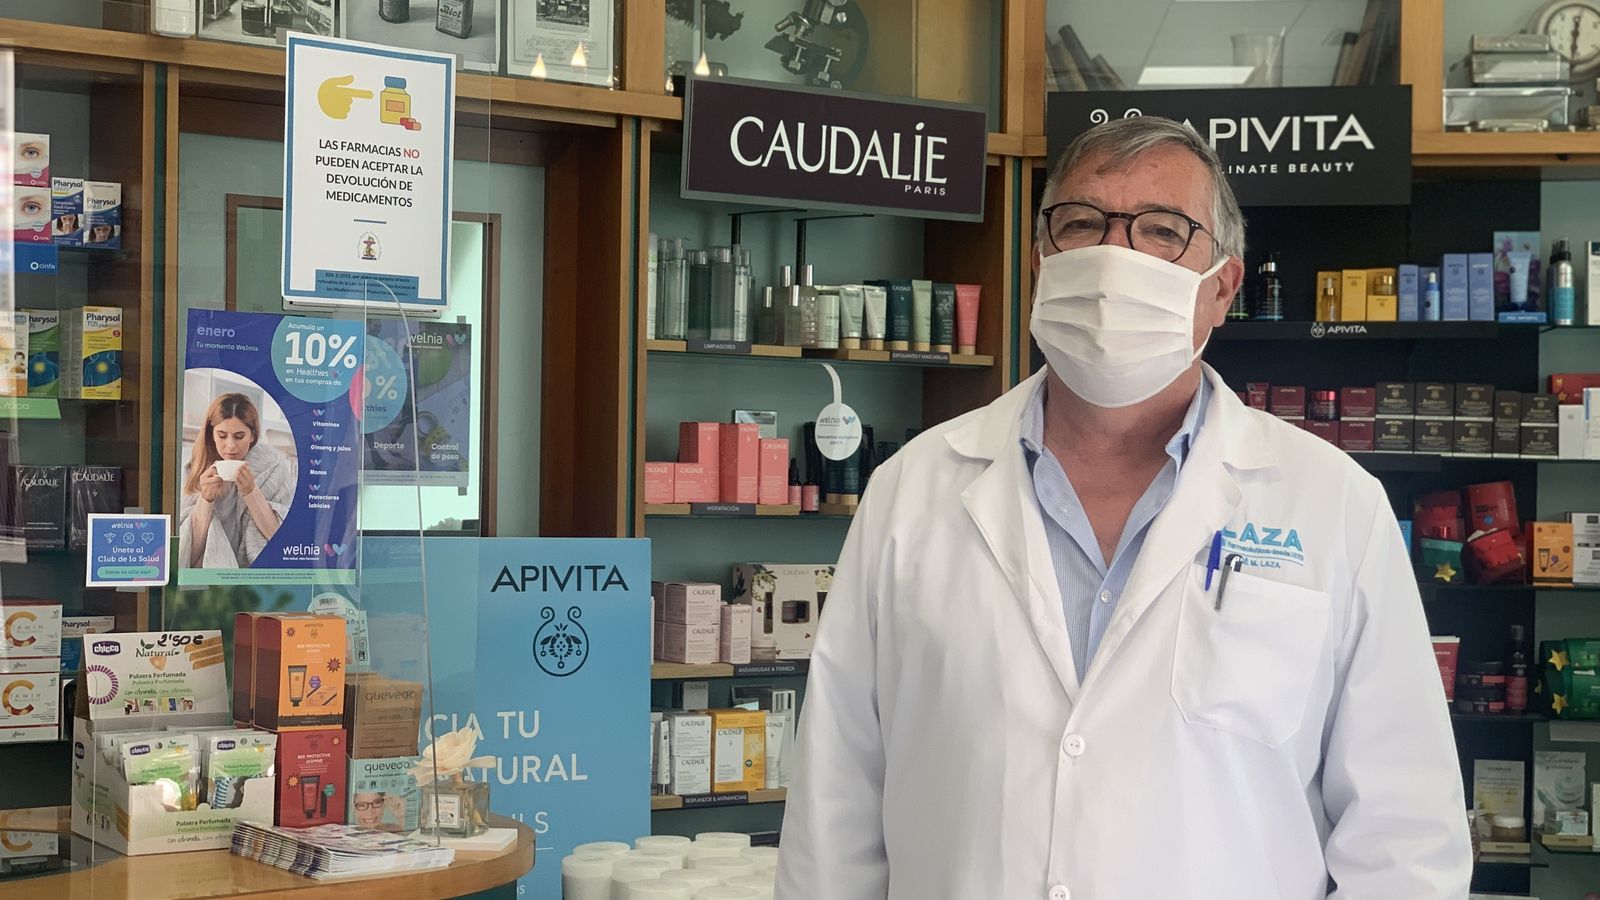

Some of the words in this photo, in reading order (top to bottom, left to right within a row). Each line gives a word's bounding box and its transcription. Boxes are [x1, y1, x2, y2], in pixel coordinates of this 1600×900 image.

[1183, 113, 1376, 152] PIVITA
[319, 138, 338, 150] LAS
[341, 141, 401, 157] FARMACIAS
[403, 148, 420, 160] NO
[315, 156, 359, 170] PUEDEN
[362, 161, 408, 175] ACEPTAR
[410, 165, 424, 176] LA
[1223, 164, 1278, 175] INATE
[1288, 162, 1354, 174] BEAUTY
[54, 180, 83, 188] Pharysol
[326, 172, 397, 190] DEVOLUCIÓN
[400, 180, 413, 192] DE
[904, 184, 946, 196] PARIS
[87, 198, 116, 206] Pharysol
[326, 190, 413, 208] MEDICAMENTOS
[29, 315, 57, 324] harysol
[86, 313, 120, 322] Pharysol
[197, 326, 236, 338] enero
[1327, 325, 1367, 334] APIVITA
[286, 332, 357, 368] 10%
[297, 368, 328, 377] Healthies
[374, 442, 404, 450] Deporte
[283, 544, 320, 555] welnia
[1261, 560, 1281, 568] LAZA
[490, 565, 629, 592] APIVITA
[94, 643, 119, 654] chicco
[136, 648, 176, 658] Natural
[496, 710, 540, 738] TU
[218, 741, 235, 749] chicco
